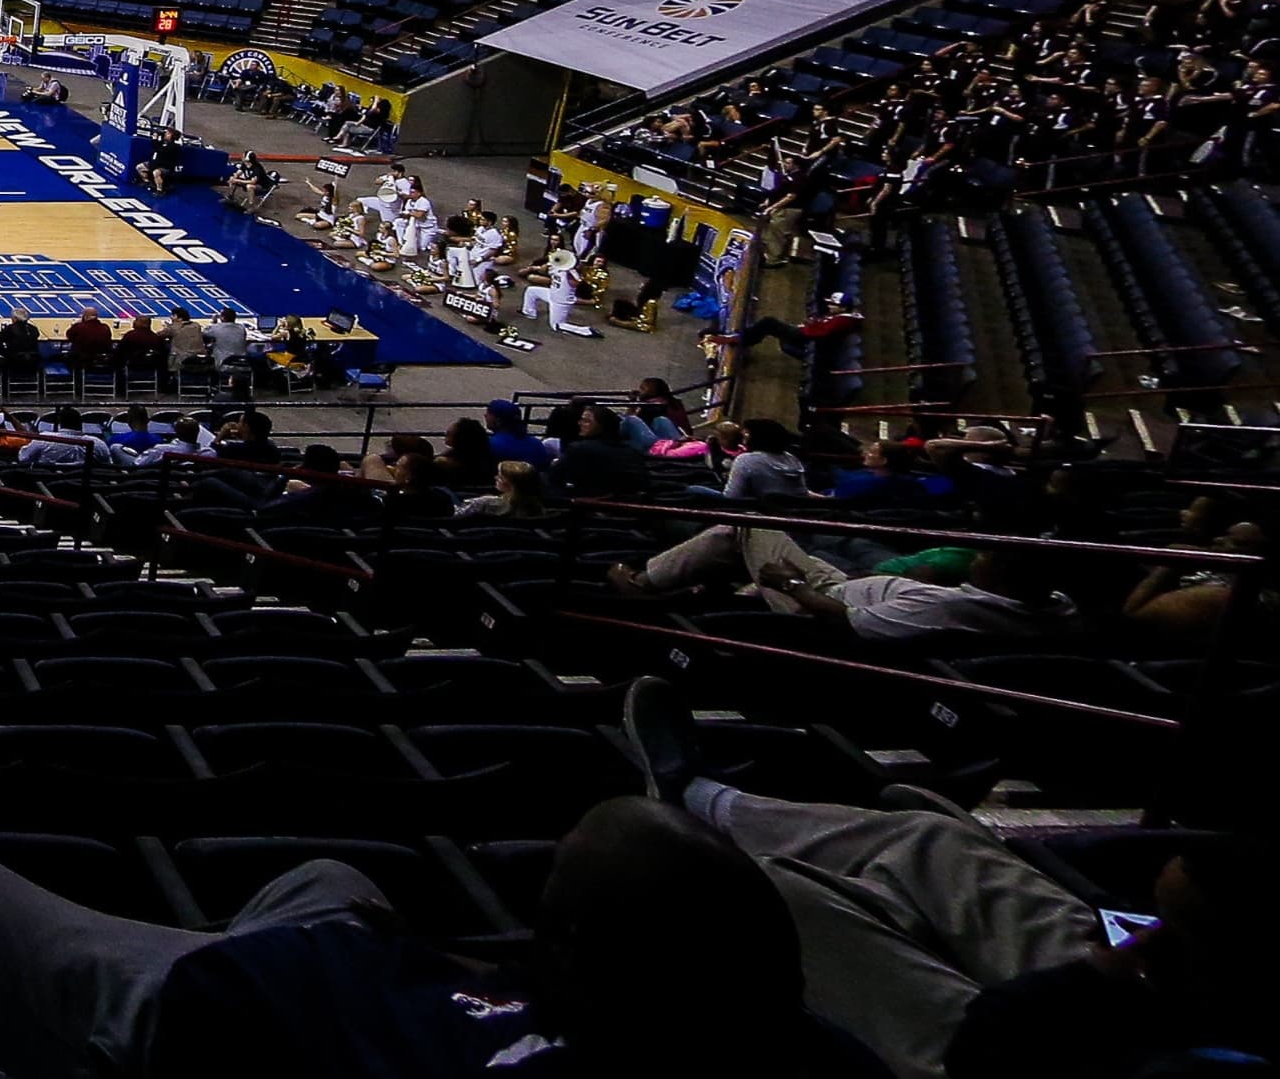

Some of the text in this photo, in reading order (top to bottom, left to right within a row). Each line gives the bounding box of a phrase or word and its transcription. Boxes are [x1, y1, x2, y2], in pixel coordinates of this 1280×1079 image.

[158, 20, 172, 30] 28
[576, 6, 727, 48] SUN BELT
[64, 36, 104, 45] GEICO
[38, 155, 230, 265] ORLEANS
[445, 293, 490, 318] DEFENSE
